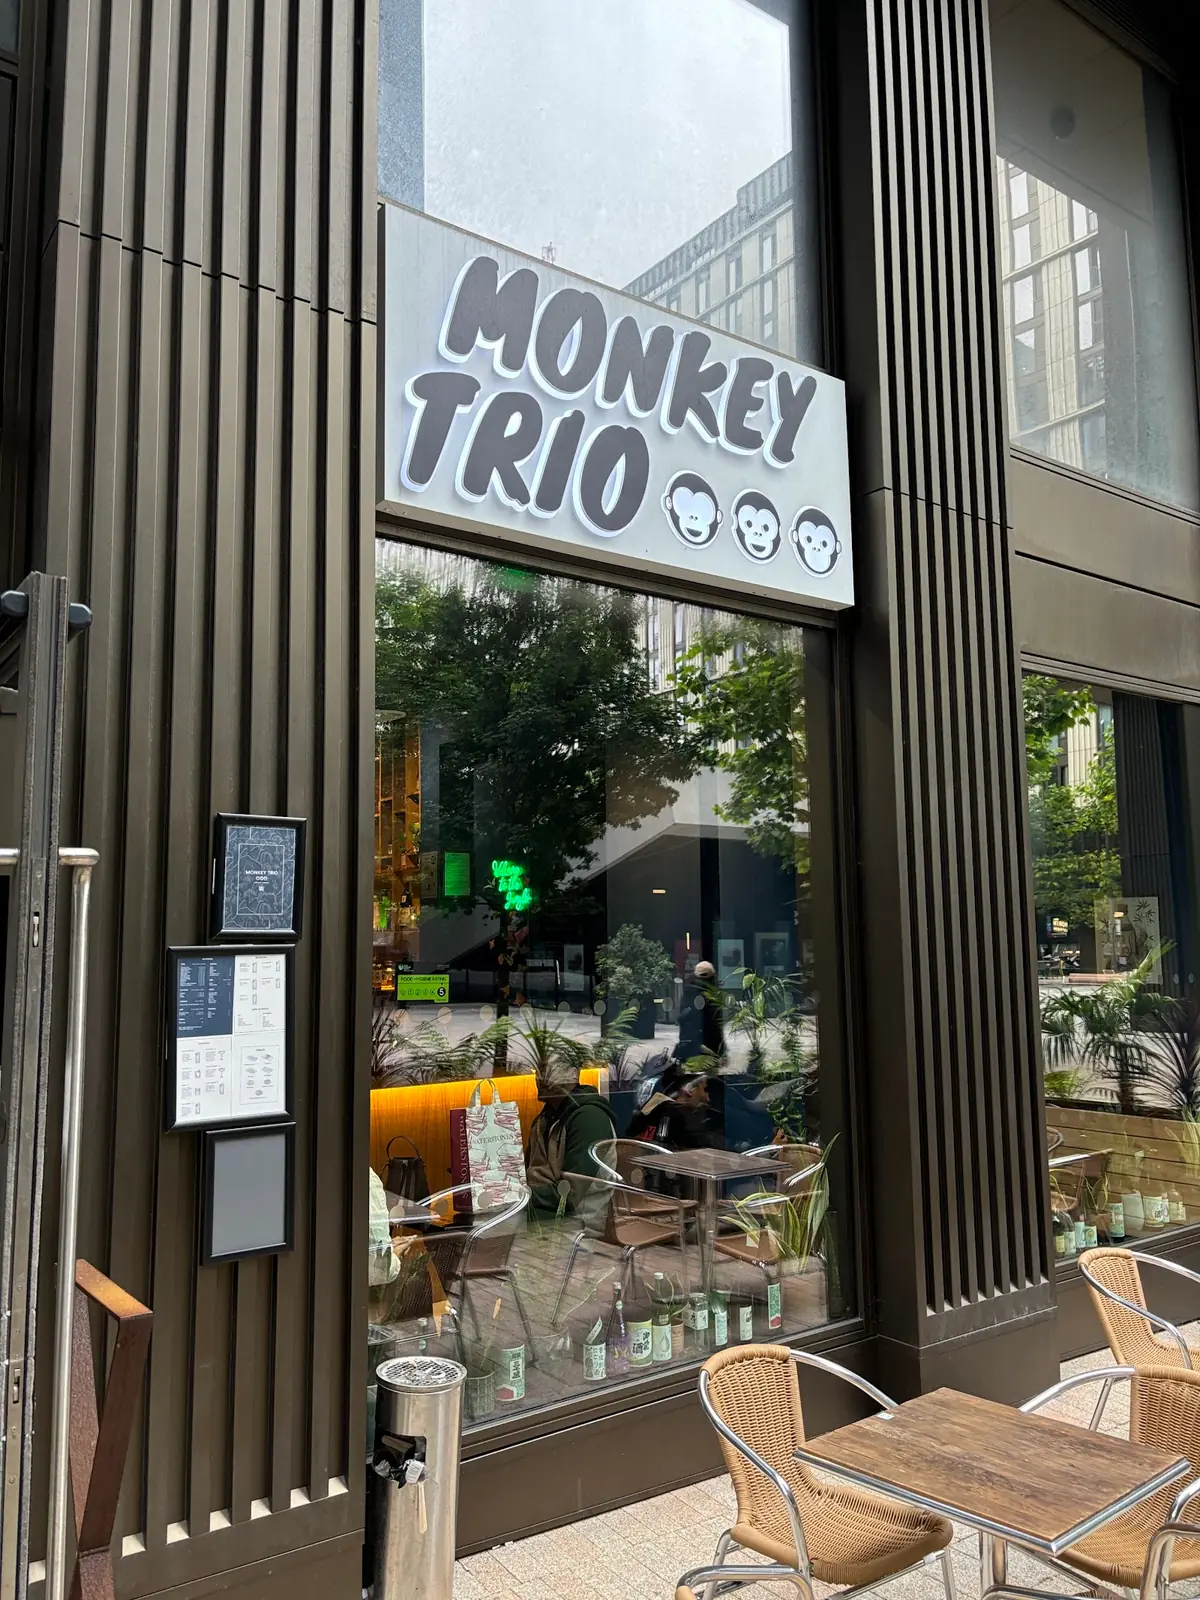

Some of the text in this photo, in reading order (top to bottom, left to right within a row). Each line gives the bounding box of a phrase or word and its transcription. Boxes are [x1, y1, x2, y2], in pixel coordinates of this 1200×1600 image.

[440, 256, 818, 467] MONKEY
[404, 372, 651, 534] TRIO
[458, 1115, 469, 1200] WATERSTONS
